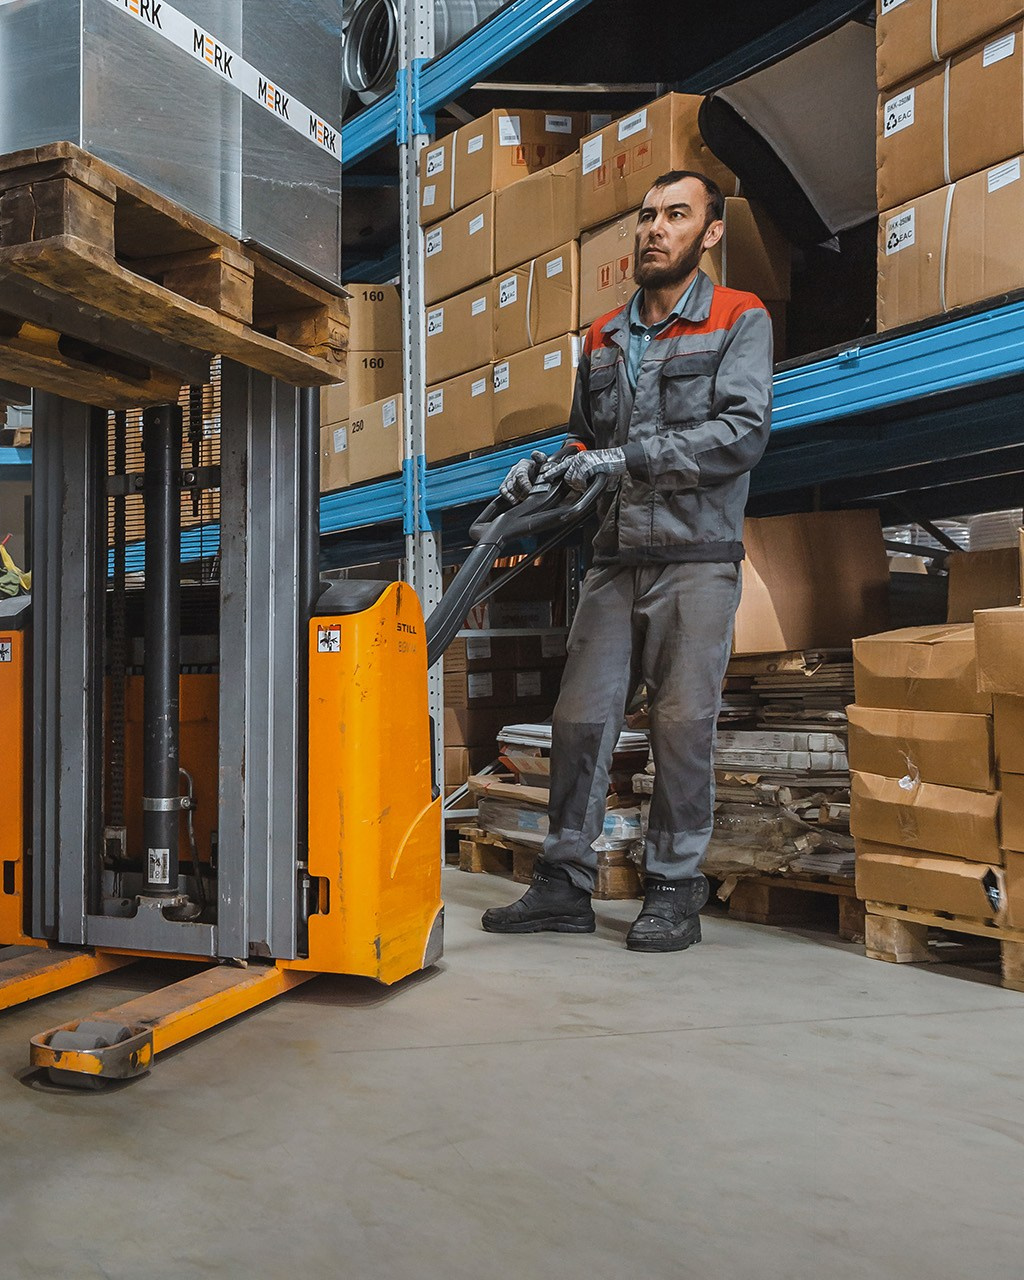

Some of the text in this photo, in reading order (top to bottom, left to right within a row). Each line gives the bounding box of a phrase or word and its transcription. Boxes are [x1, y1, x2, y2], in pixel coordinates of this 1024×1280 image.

[193, 29, 233, 79] MERK
[257, 77, 289, 120] MERK
[309, 115, 336, 153] MERK
[897, 110, 912, 123] EAC
[899, 230, 912, 243] EAC
[362, 291, 384, 302] 160
[362, 358, 384, 369] 160
[351, 420, 364, 434] 250
[396, 622, 417, 635] STILL
